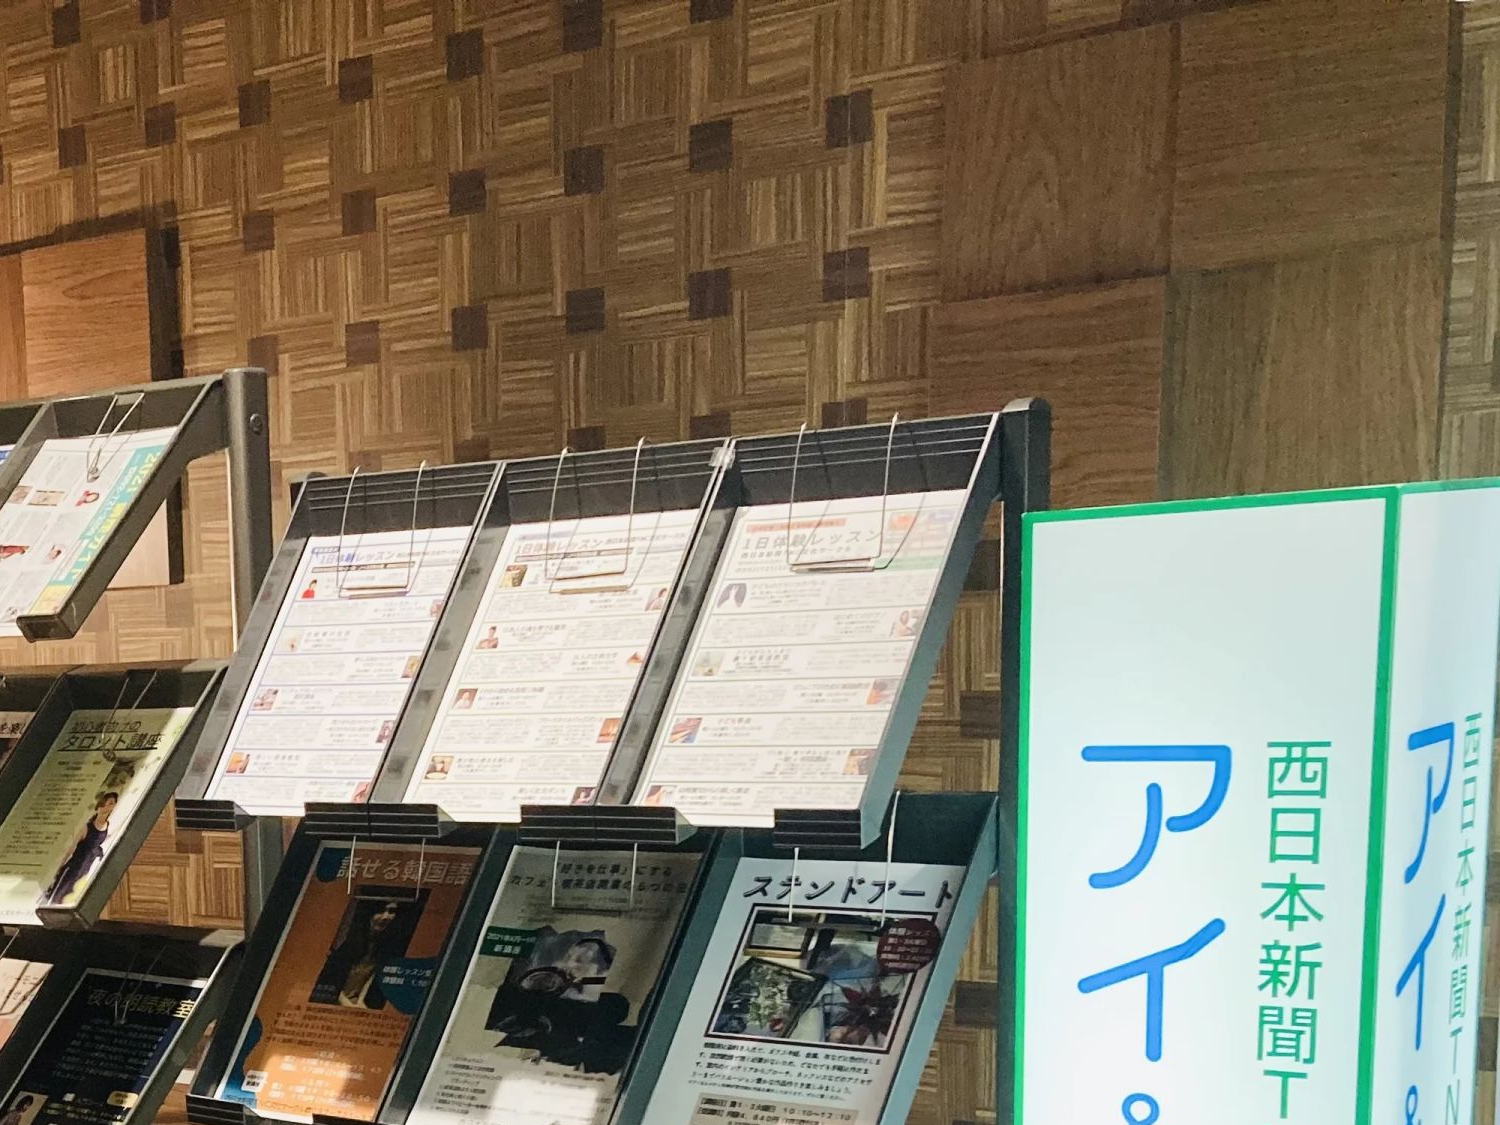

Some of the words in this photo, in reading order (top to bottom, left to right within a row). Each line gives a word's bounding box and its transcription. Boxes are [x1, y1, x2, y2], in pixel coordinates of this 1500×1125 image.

[741, 529, 883, 552] 1日体験レッスン
[73, 720, 143, 733] 初心者向けの
[62, 733, 164, 750] タロット講座
[336, 856, 474, 885] 話せる韓国語
[742, 875, 953, 910] ステンドアート
